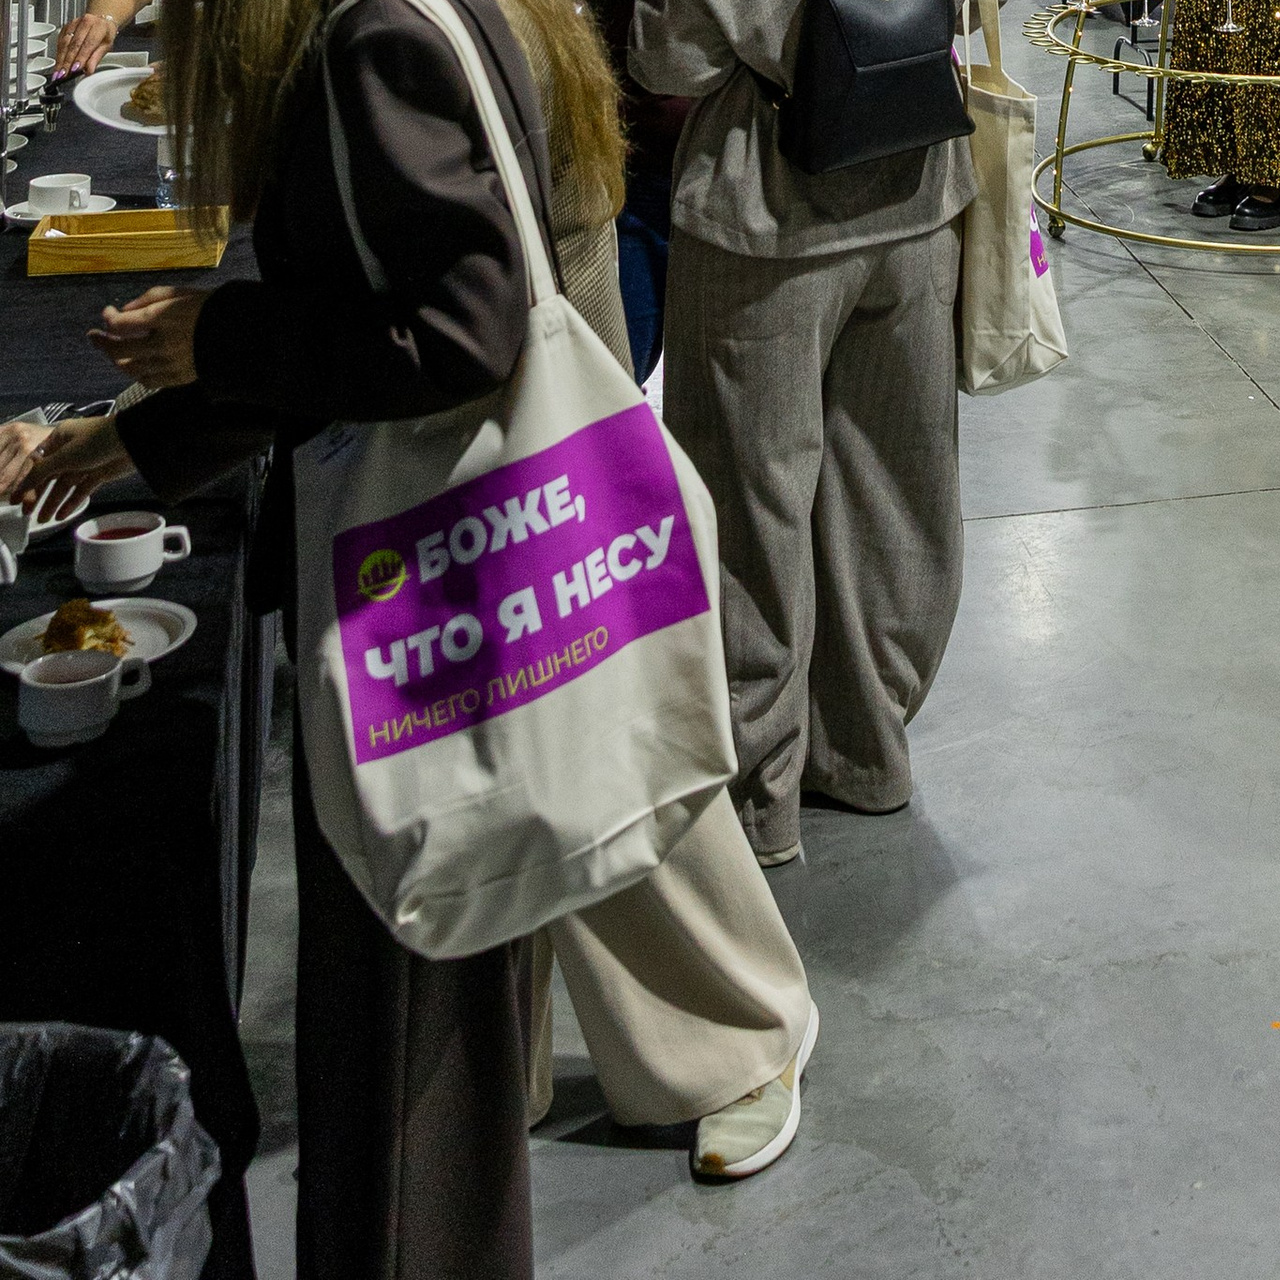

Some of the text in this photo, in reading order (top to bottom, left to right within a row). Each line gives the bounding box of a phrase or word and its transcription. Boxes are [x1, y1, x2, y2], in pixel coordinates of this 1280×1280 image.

[415, 473, 586, 585] БОЖЕ,
[364, 514, 675, 687] ЧТО Я НЕСУ
[367, 625, 609, 748] НИЧЕГО ЛИШНЕГО
